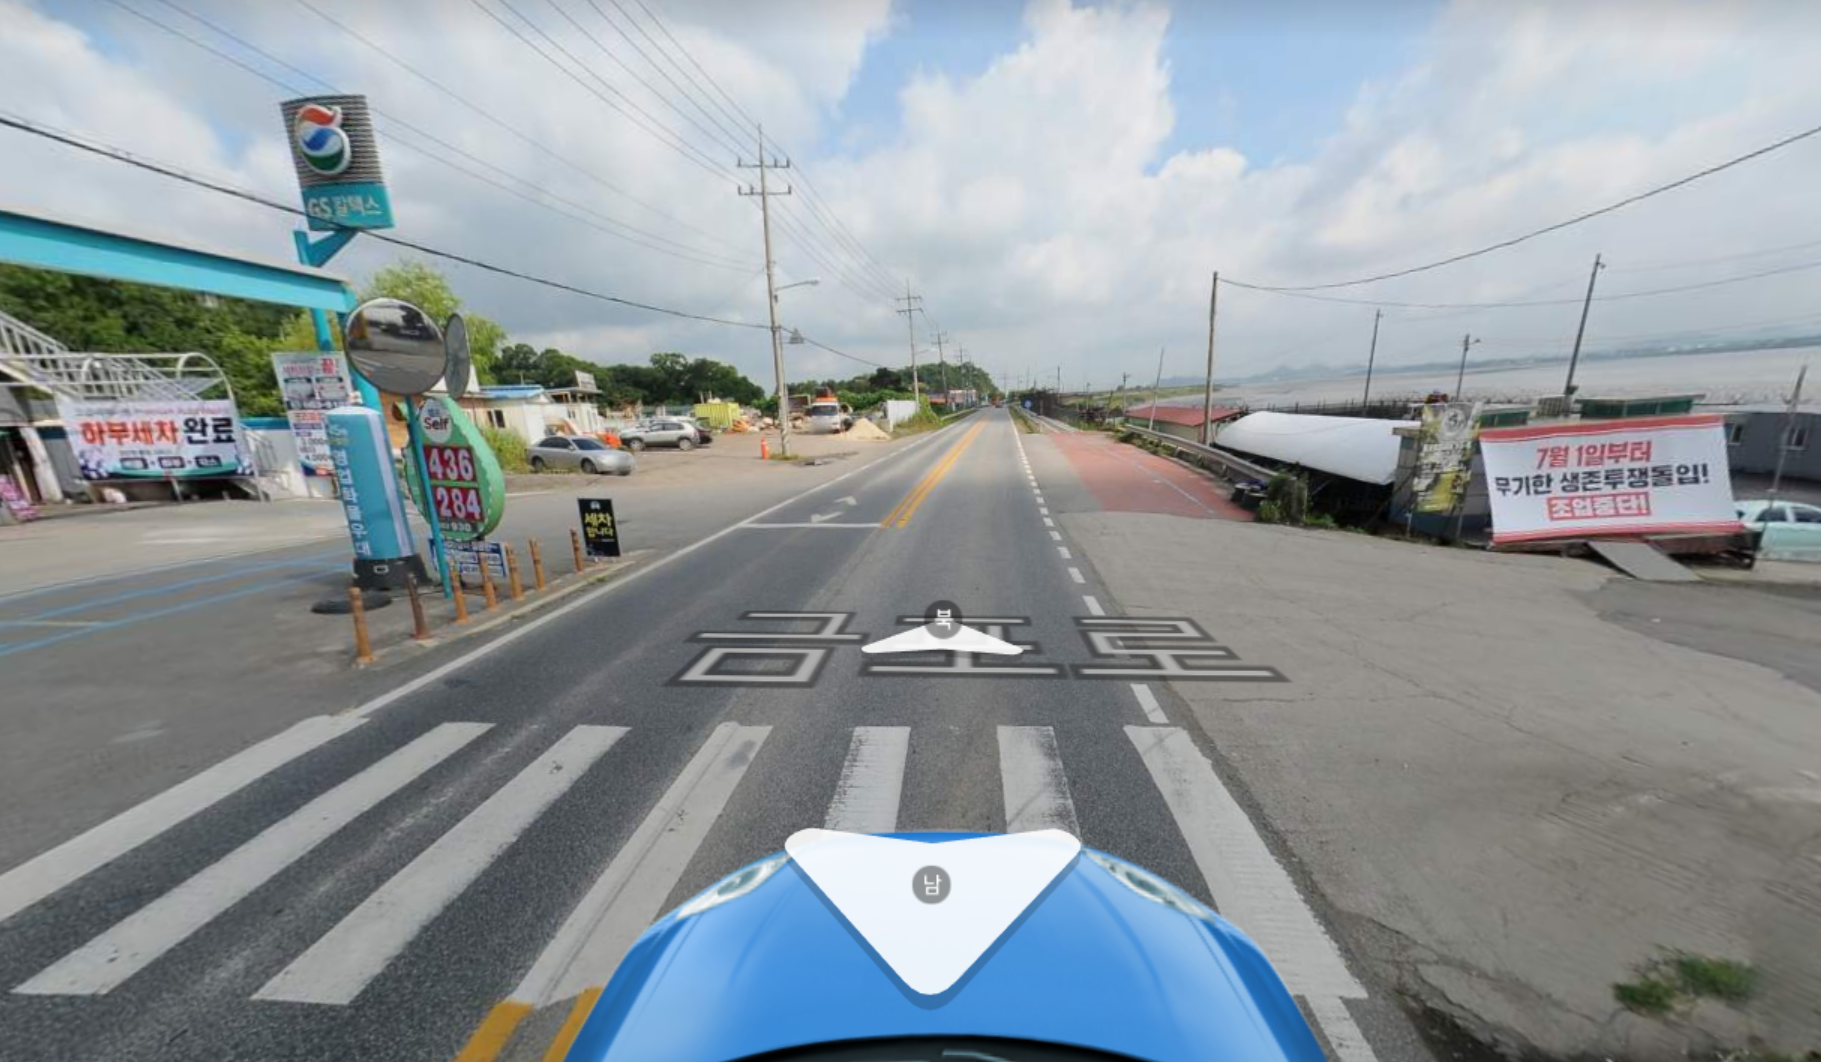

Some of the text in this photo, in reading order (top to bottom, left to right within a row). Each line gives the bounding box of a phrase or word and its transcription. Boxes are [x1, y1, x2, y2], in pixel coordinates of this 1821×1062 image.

[183, 417, 236, 445] 완료
[424, 415, 450, 430] Self
[1536, 440, 1653, 470] 7월 1일부터
[1494, 473, 1553, 497] 무기한
[1559, 463, 1710, 494] 생존투쟁돌입!
[1550, 494, 1647, 518] 조업중단!
[584, 512, 613, 528] 세차
